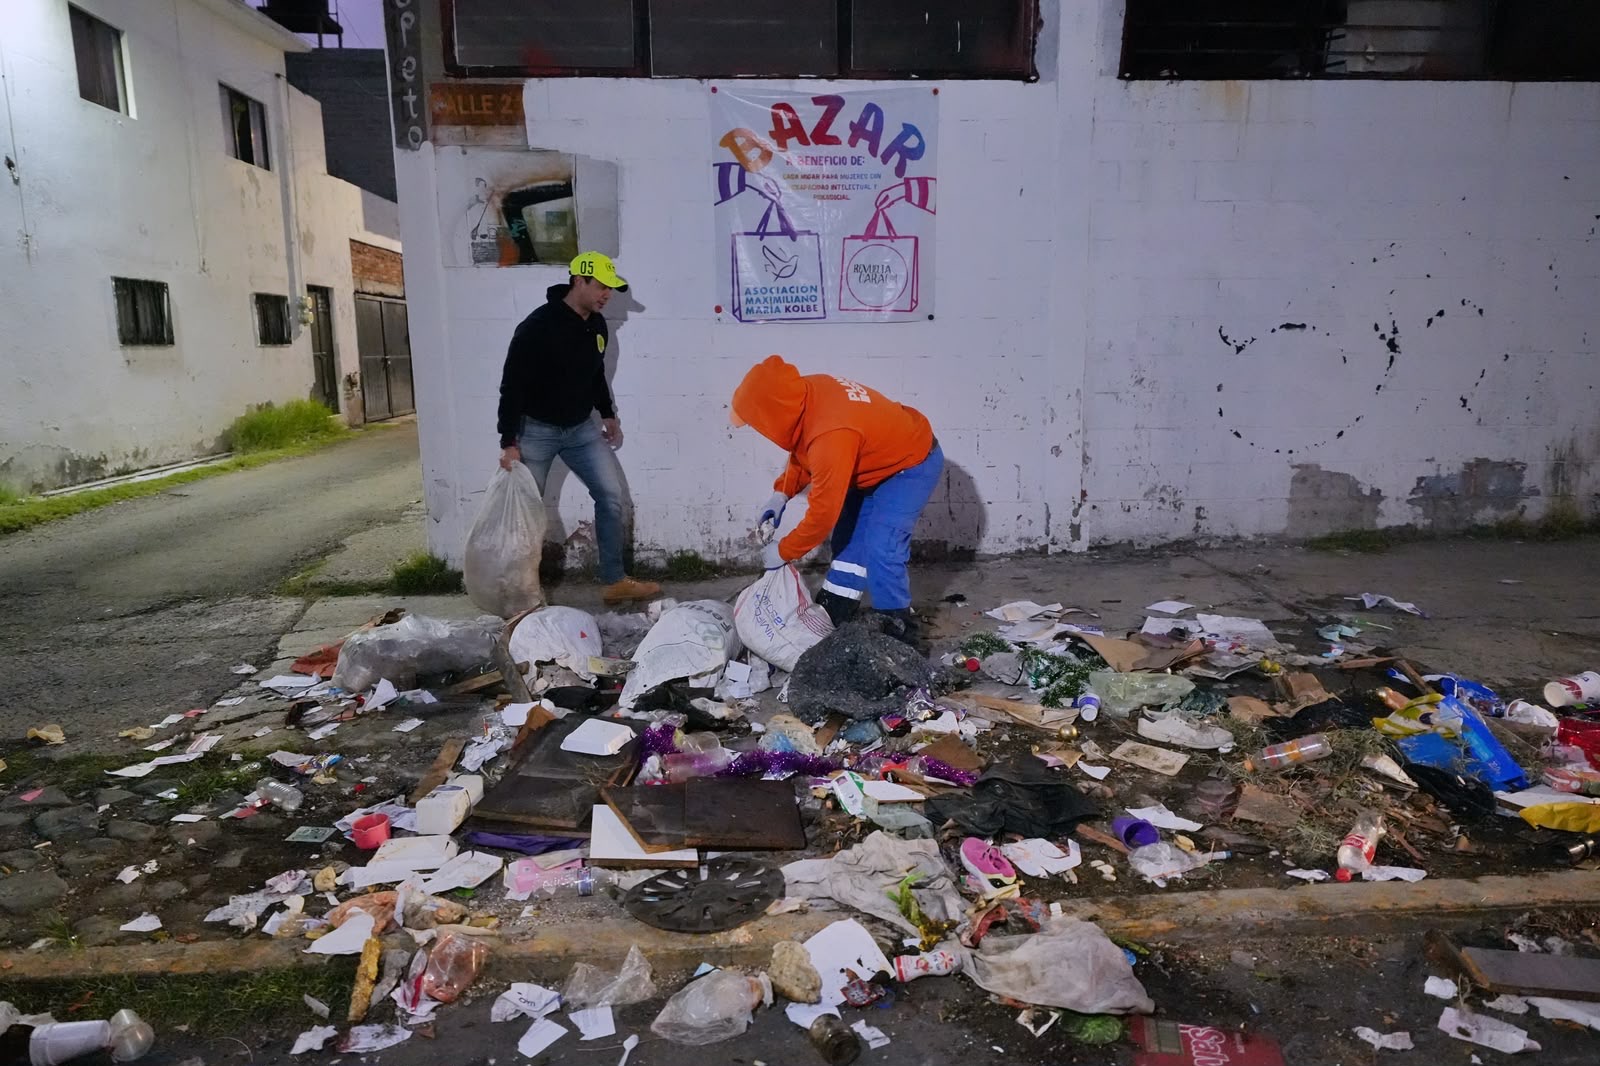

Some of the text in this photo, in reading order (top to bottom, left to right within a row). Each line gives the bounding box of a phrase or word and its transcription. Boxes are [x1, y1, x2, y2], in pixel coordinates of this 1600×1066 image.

[432, 94, 495, 114] ALLE
[719, 94, 926, 178] BAZAR
[797, 155, 848, 166] BENEFICIO
[580, 260, 594, 275] 05
[745, 294, 818, 305] MAXIMILIANO
[784, 304, 819, 313] KOLBE
